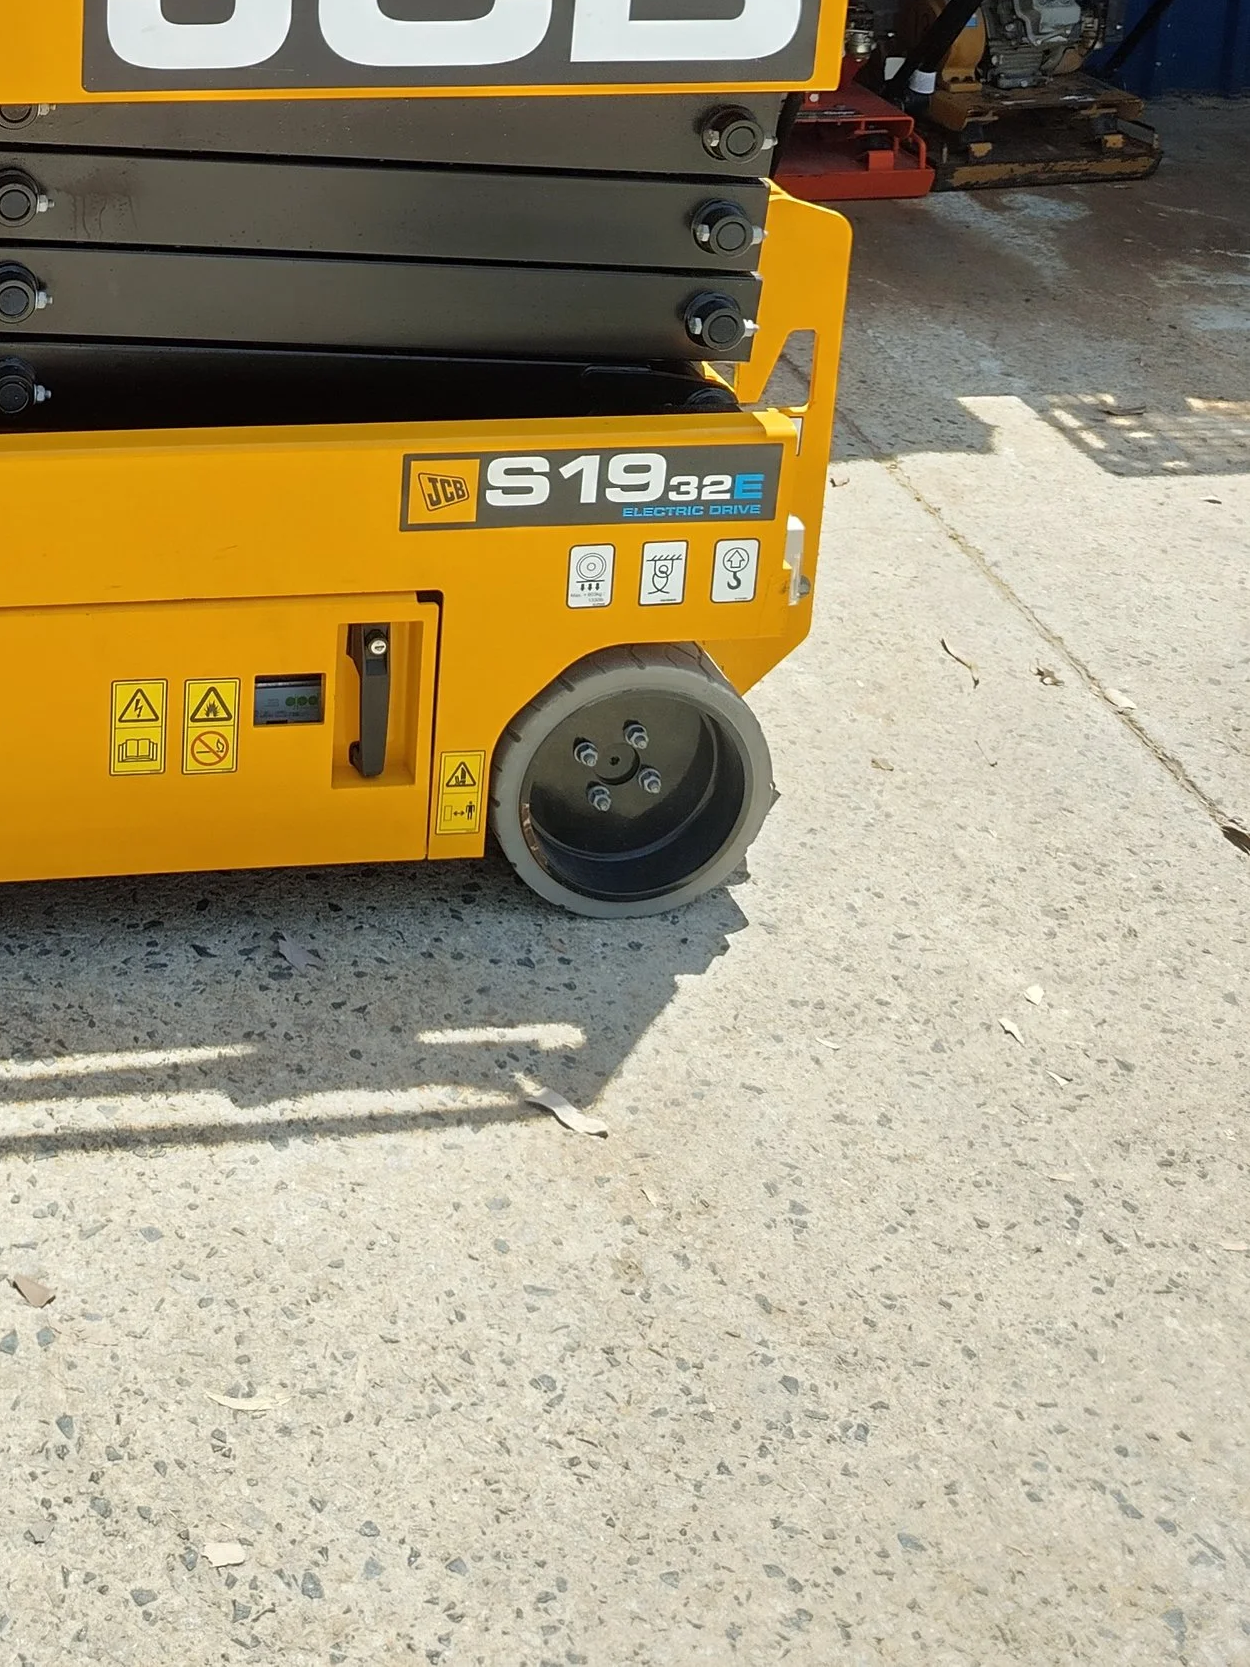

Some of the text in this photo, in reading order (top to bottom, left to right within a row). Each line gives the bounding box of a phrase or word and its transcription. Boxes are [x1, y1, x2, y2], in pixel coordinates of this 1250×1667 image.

[427, 477, 466, 507] JCB
[622, 504, 761, 518] ELECTRIC DRIVE
